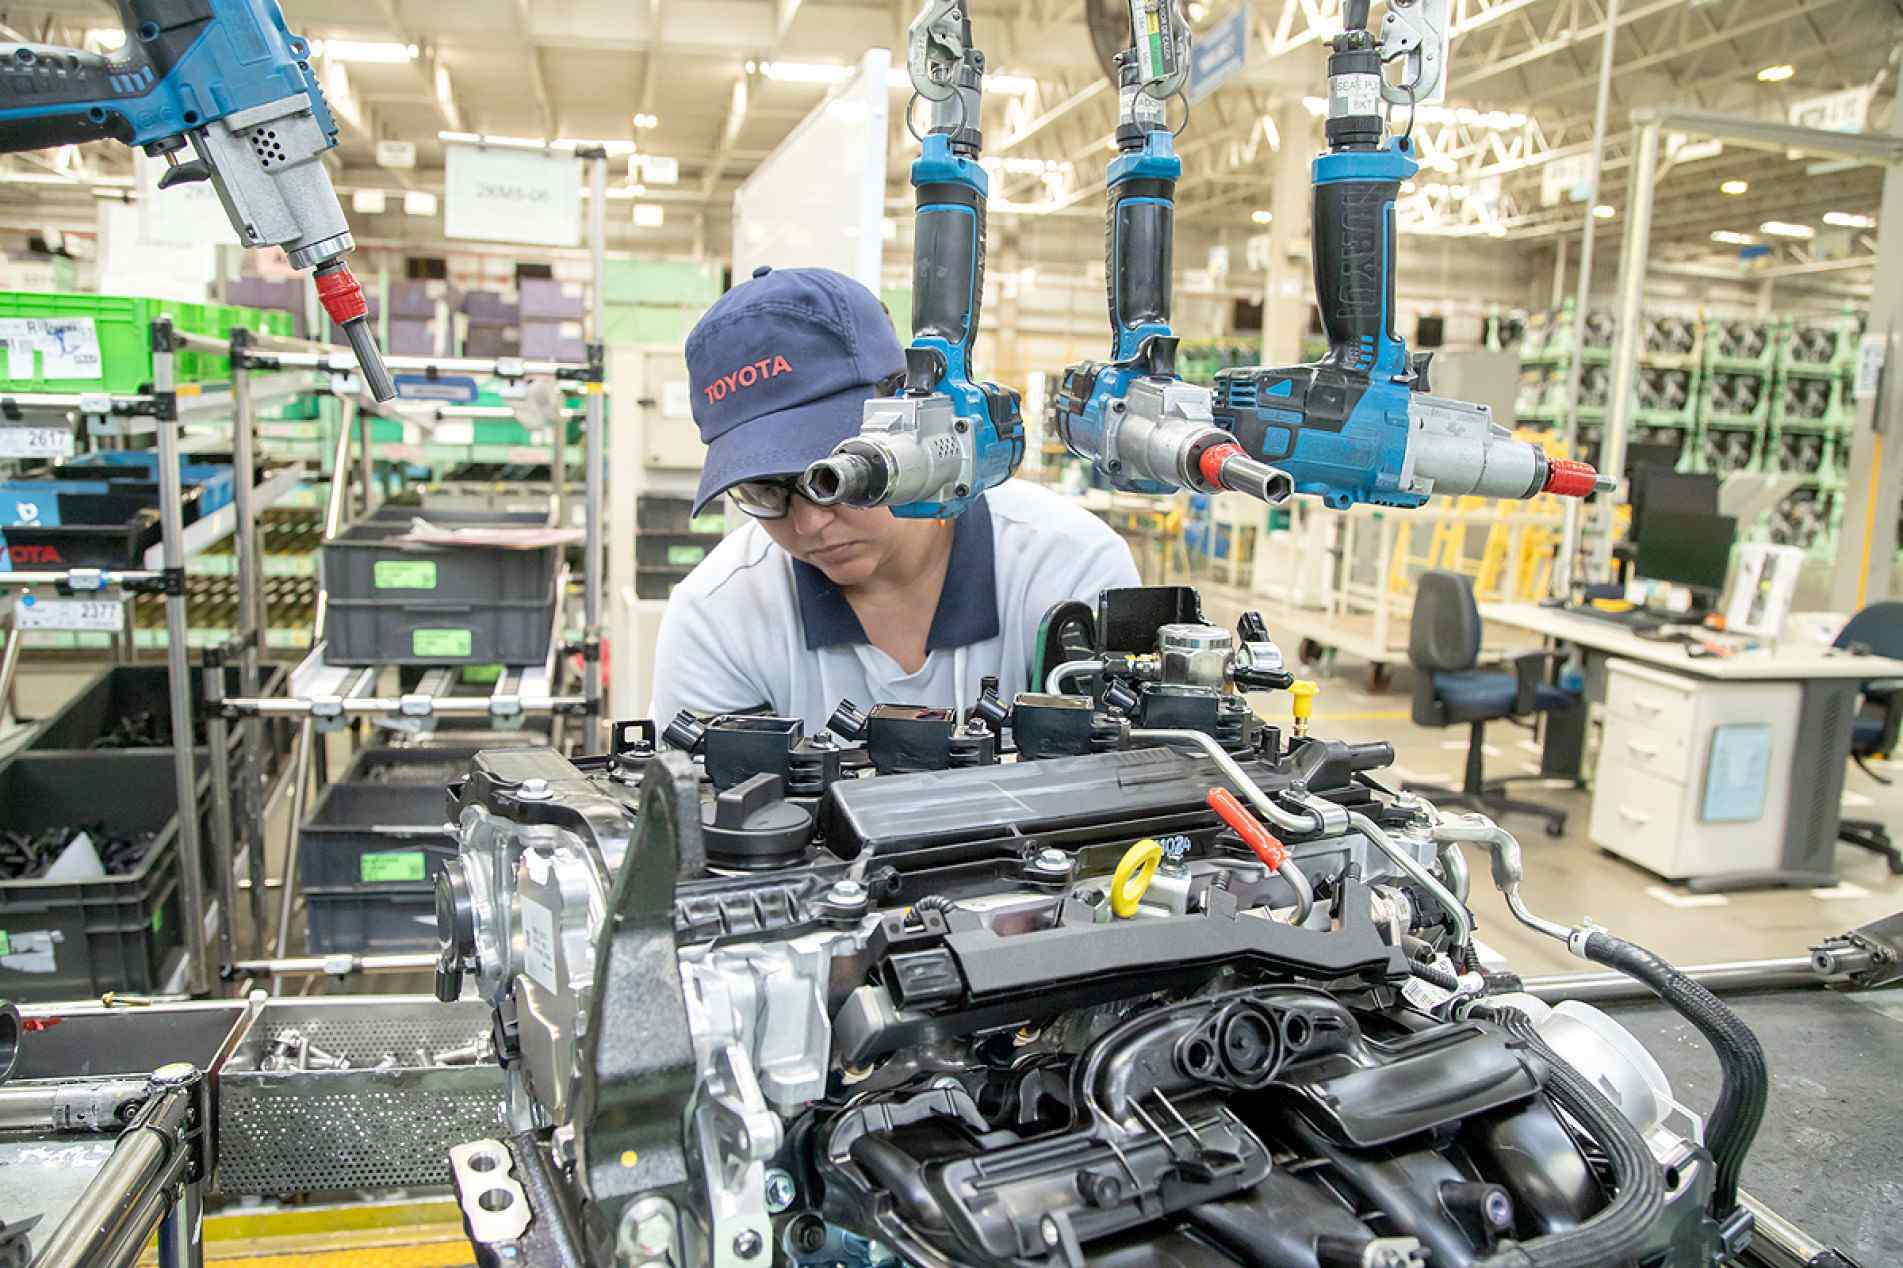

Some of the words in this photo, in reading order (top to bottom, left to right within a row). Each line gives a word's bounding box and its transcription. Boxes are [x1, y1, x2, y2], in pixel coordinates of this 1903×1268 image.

[703, 354, 793, 406] TOYOTA
[29, 430, 66, 447] 2617
[81, 603, 116, 619] 2377
